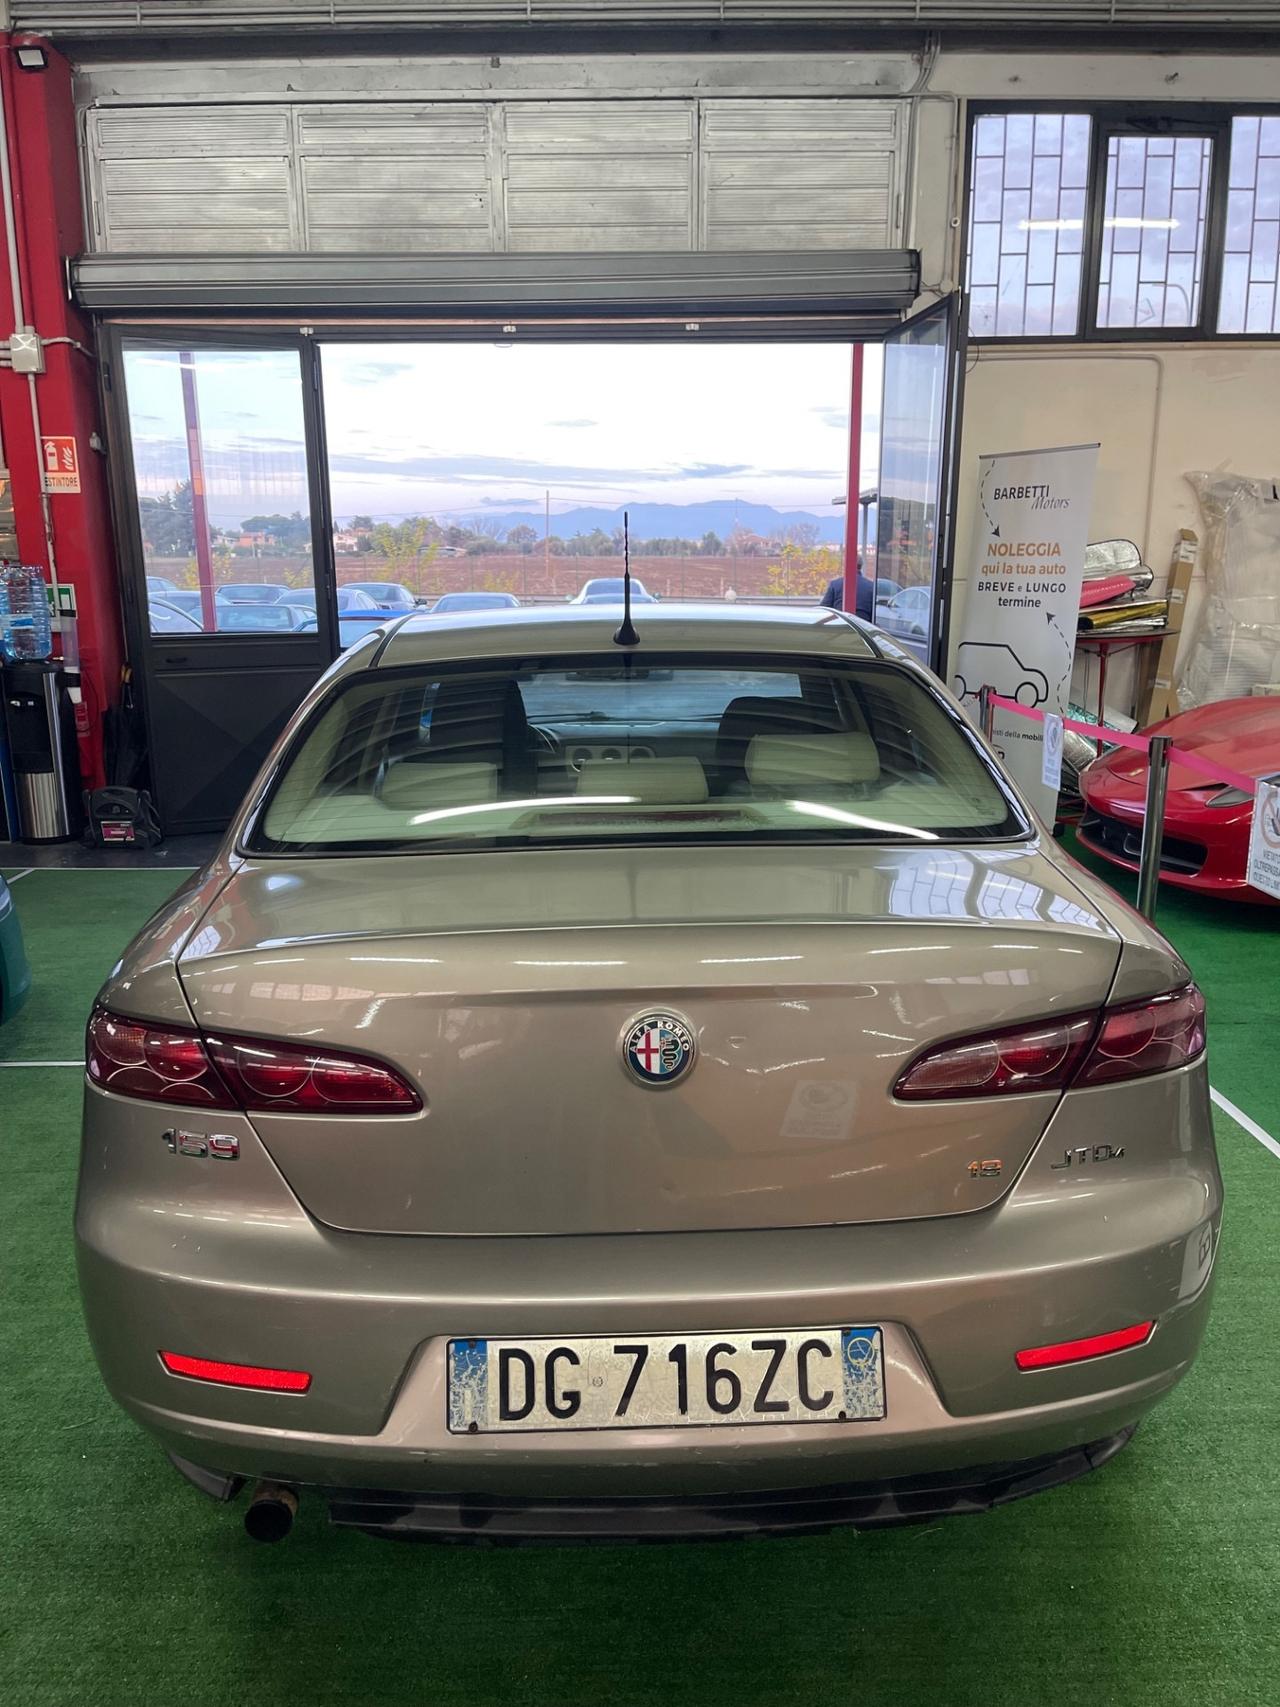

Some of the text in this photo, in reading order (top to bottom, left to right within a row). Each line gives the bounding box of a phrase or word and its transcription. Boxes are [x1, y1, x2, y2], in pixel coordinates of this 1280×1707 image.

[44, 476, 78, 487] ESTINTORE
[994, 485, 1050, 500] BARBETTI
[1031, 496, 1070, 510] Motors
[987, 543, 1062, 557] NOLEGGIA
[981, 561, 1067, 577] qui la tua auto
[977, 581, 1015, 592] BREVE
[1026, 582, 1067, 593] LUNGO
[998, 596, 1042, 608] termine
[1004, 730, 1021, 739] della
[1021, 732, 1044, 742] mobili
[629, 1020, 690, 1053] ALFA ROMEO
[161, 1127, 240, 1160] 159
[499, 1338, 835, 1421] DG 716ZC
